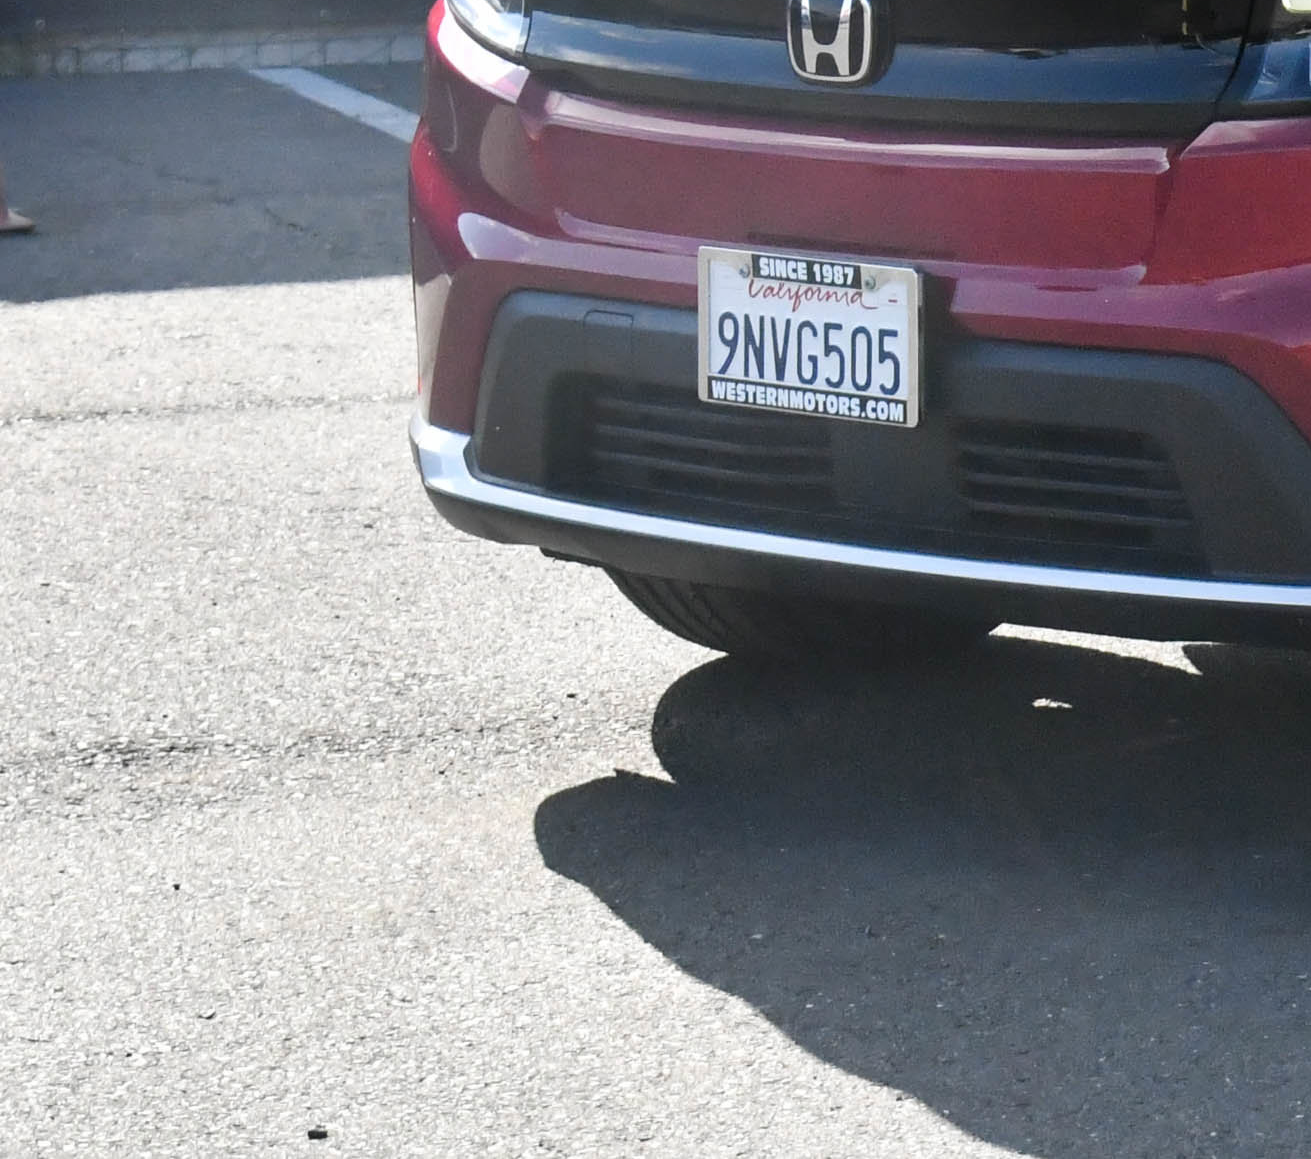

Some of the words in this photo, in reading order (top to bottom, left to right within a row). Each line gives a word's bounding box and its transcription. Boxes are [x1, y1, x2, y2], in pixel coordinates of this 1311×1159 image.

[759, 257, 807, 281] SINCE
[813, 264, 855, 286] 1987
[718, 311, 900, 396] 9NVG505
[711, 380, 904, 422] WESTERNMOTORS.COM
